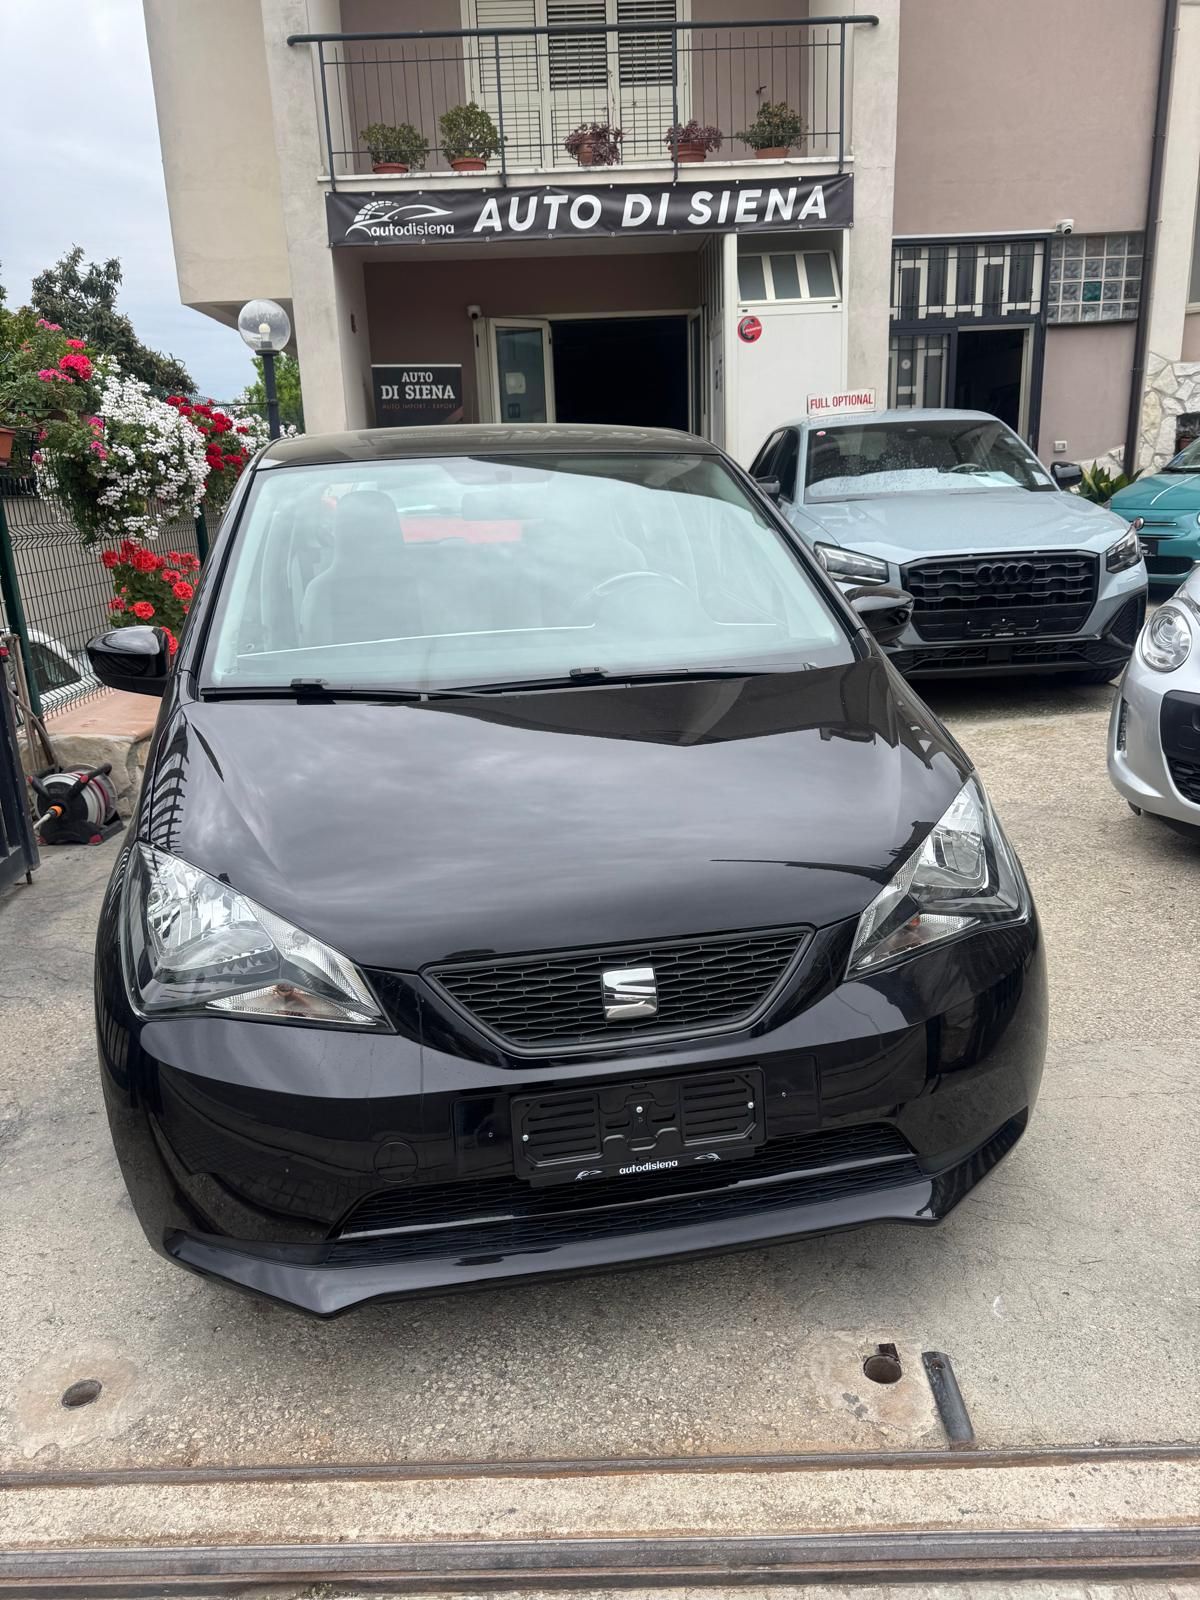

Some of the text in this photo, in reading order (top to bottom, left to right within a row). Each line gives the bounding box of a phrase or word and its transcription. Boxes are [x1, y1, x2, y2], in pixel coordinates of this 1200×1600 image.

[472, 185, 827, 233] AUTO DI SIENA
[370, 221, 455, 237] autodisiena
[401, 371, 433, 383] AUTO
[380, 384, 456, 400] DI SIENA
[810, 393, 874, 410] FULL OPTIONAL
[619, 1159, 678, 1175] autodisiena
